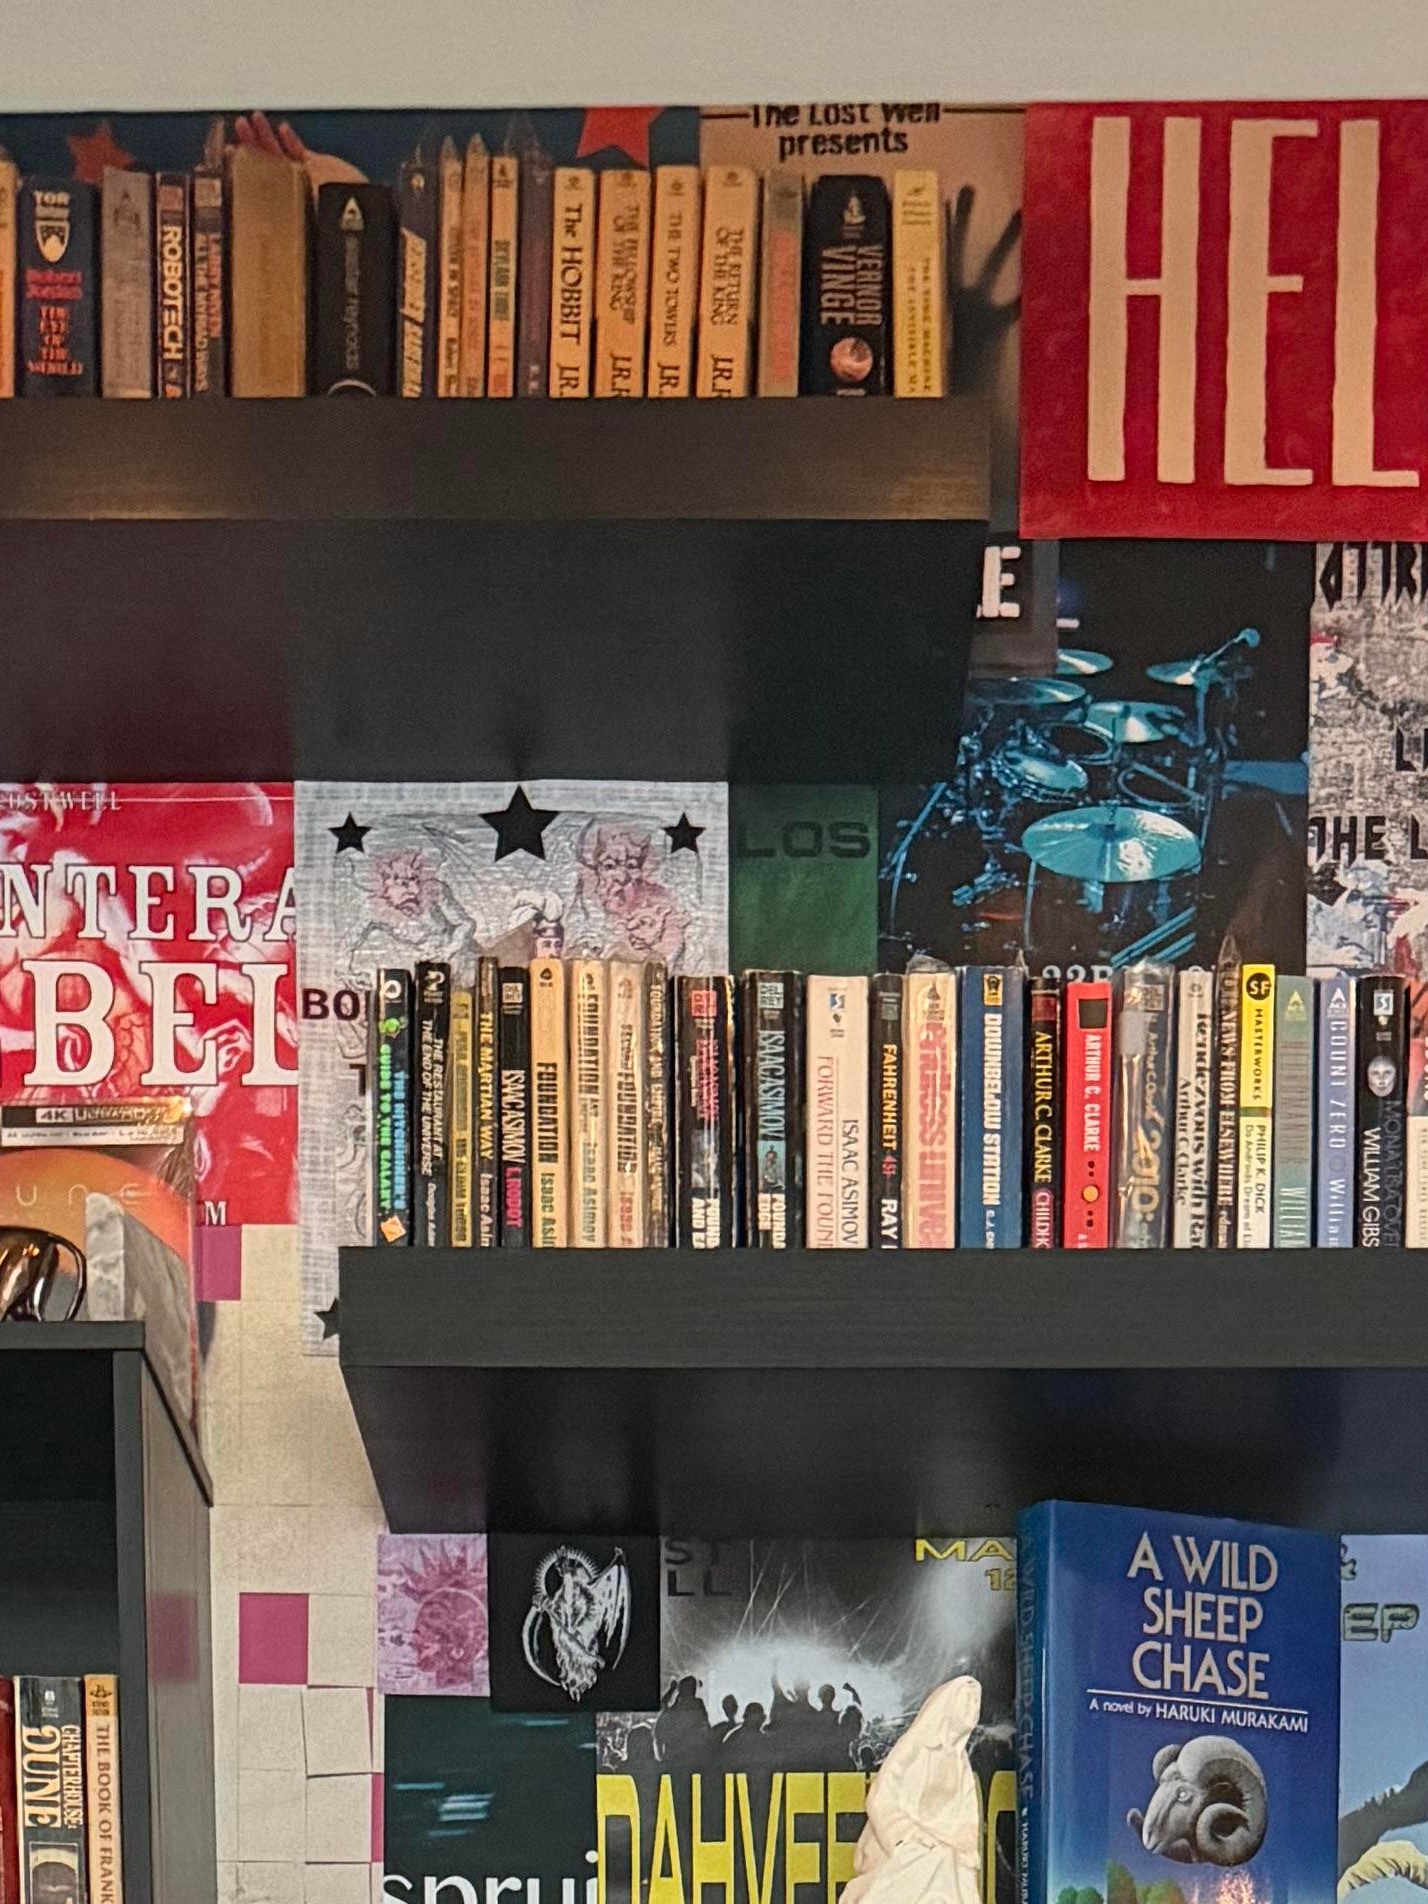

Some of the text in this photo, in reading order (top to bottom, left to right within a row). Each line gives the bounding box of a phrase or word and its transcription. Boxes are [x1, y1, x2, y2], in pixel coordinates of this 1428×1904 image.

[777, 126, 909, 163] presents
[557, 243, 583, 347] HOBBIT
[819, 245, 856, 327] VINGE
[855, 243, 885, 327] VERNOR
[1172, 1538, 1278, 1593] WILD
[1142, 1585, 1264, 1643] SHEEP
[1132, 1640, 1270, 1699] CHASE
[1220, 1710, 1309, 1733] MURAKAMI
